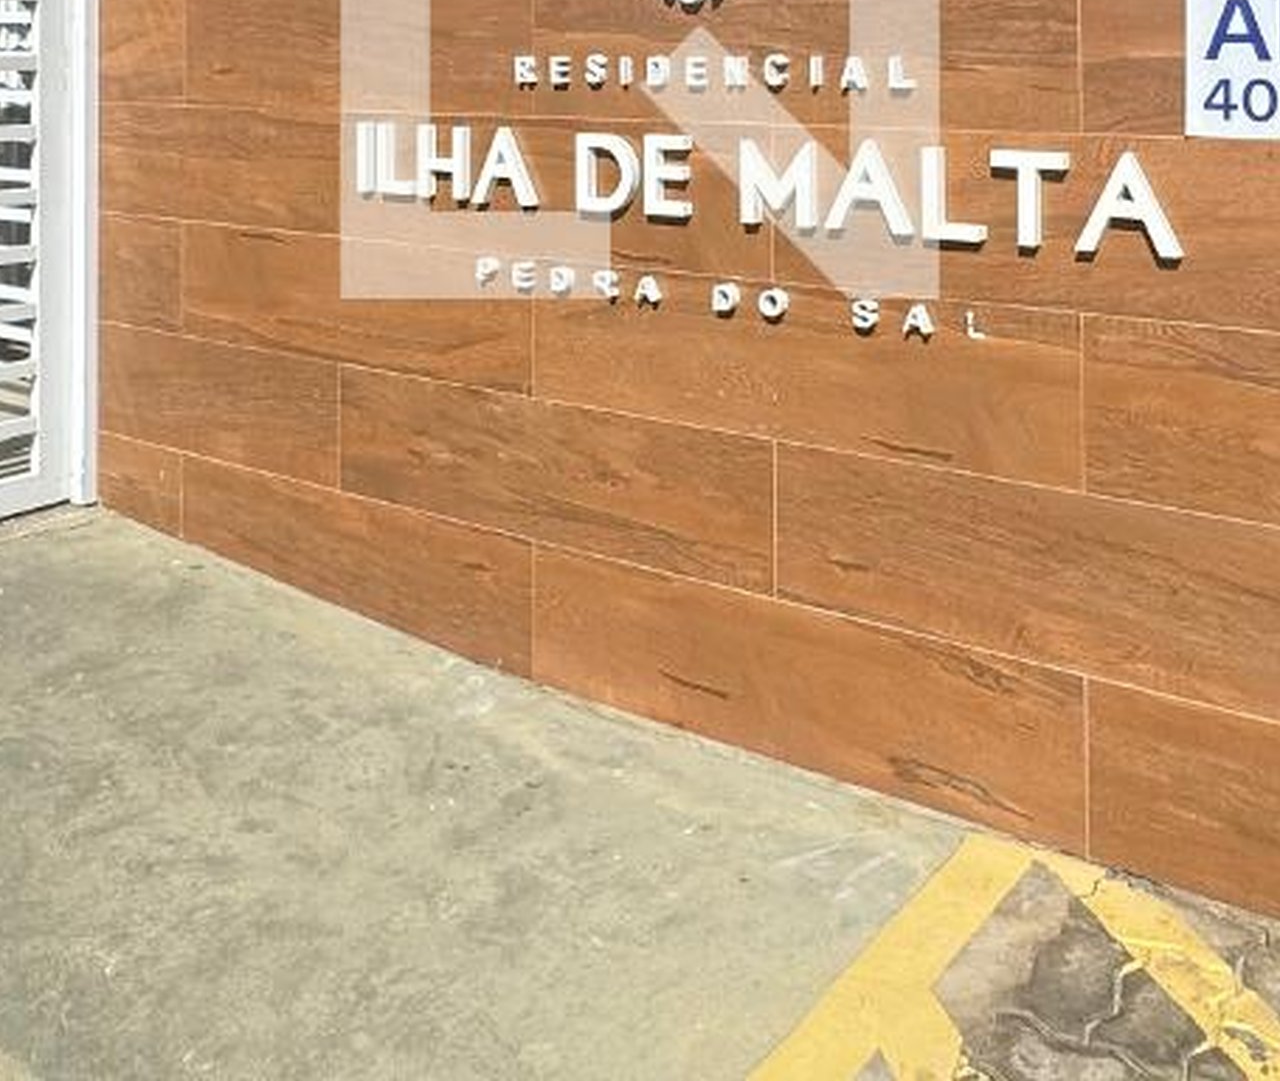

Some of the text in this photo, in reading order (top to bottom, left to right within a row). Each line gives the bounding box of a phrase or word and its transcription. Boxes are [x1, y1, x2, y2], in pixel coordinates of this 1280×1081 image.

[513, 52, 918, 91] RESIDENCIAL
[356, 119, 1184, 263] ILHA DE MALTA
[475, 255, 986, 341] PEDRA DO SAL
